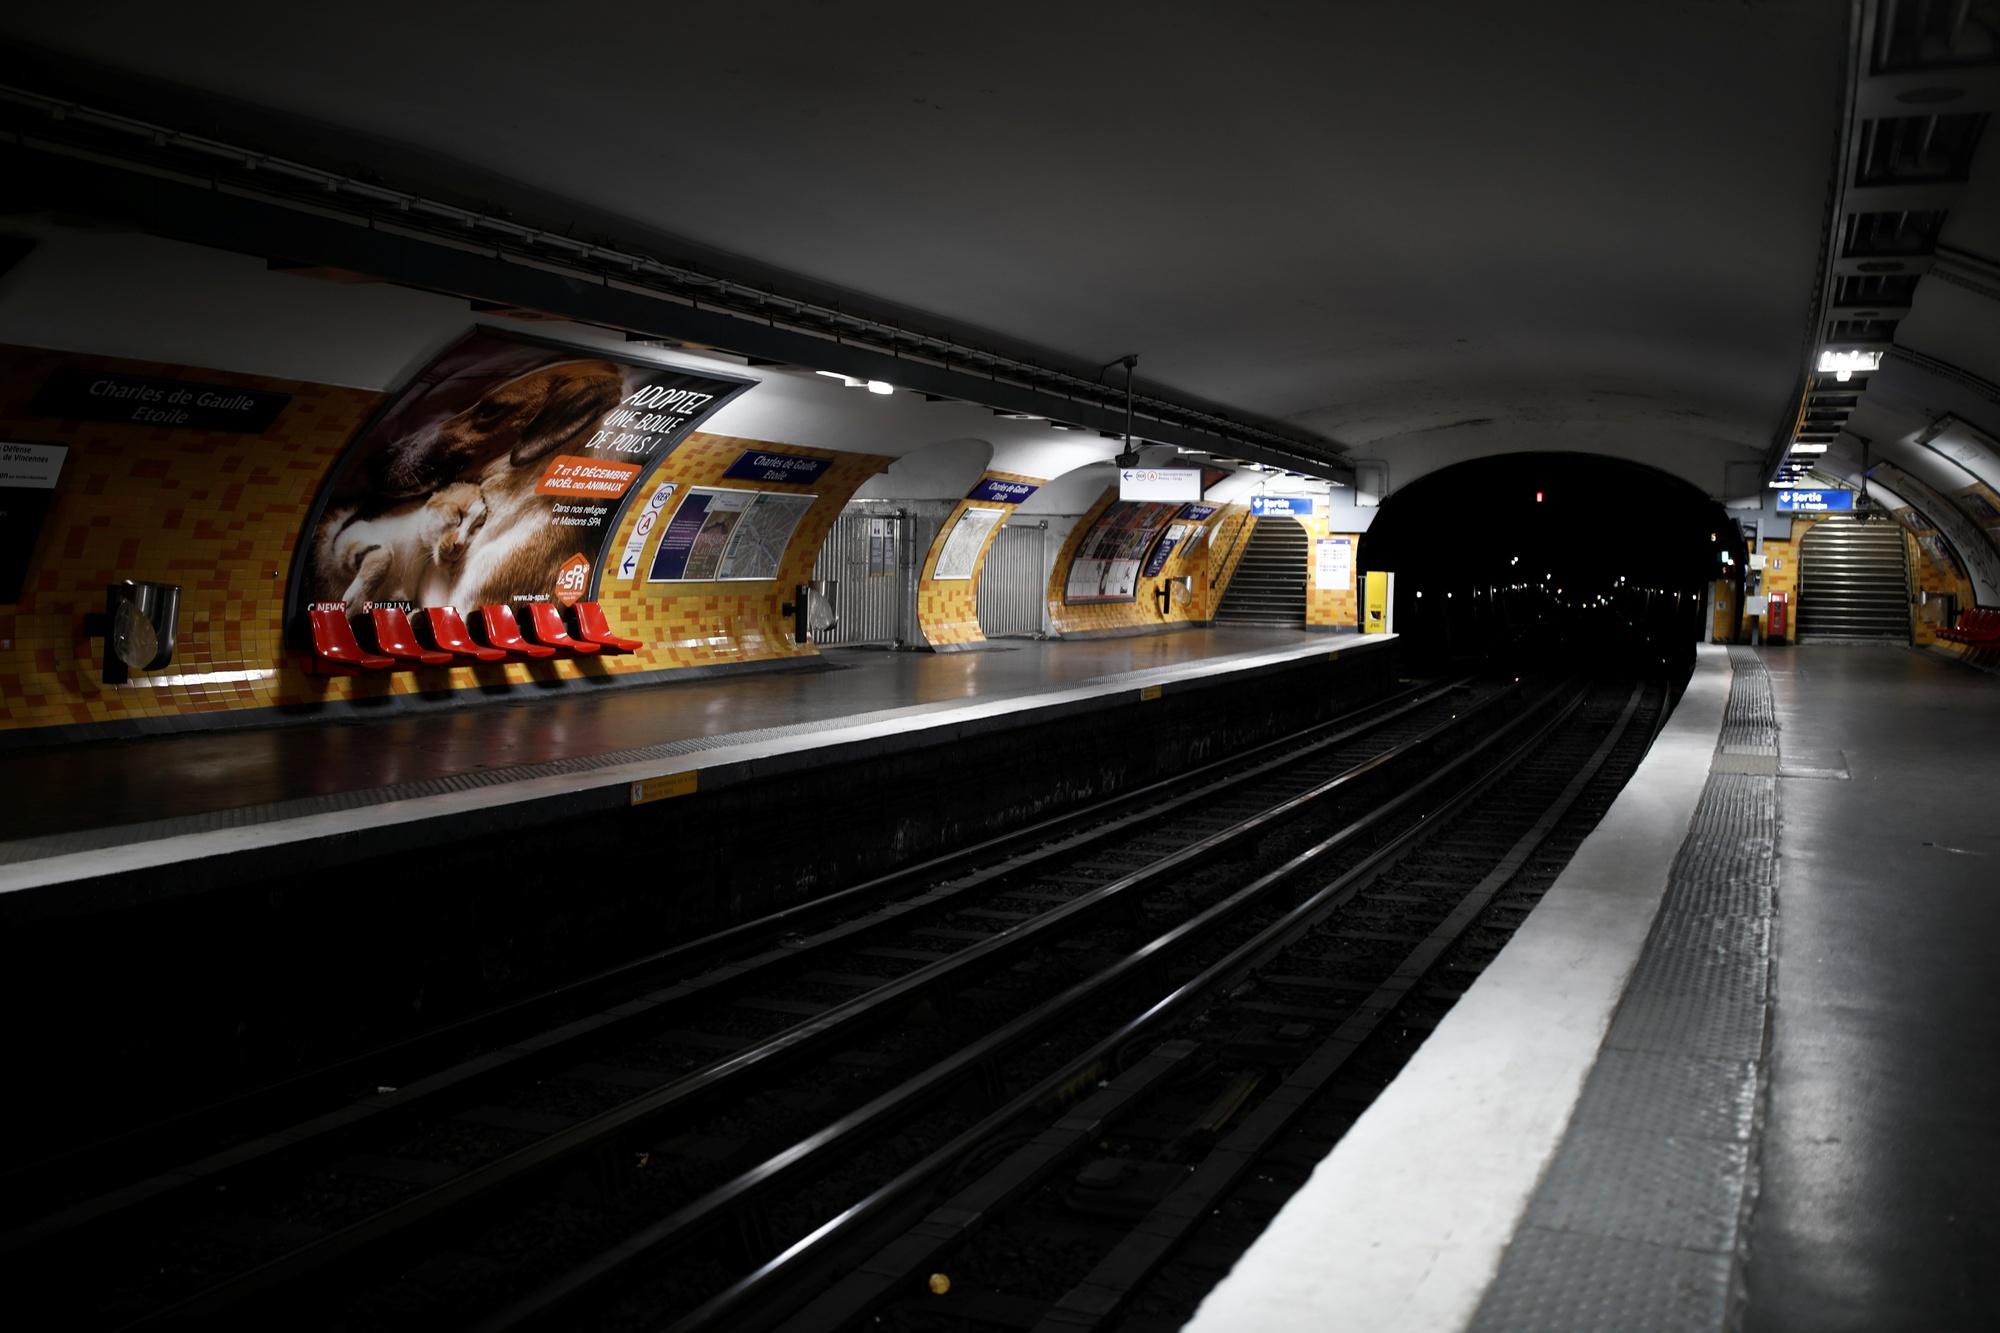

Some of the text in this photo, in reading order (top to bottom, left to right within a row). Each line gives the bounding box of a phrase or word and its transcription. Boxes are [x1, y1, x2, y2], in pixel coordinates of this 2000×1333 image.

[88, 379, 255, 412] Charles de Gaulle
[622, 384, 714, 415] ADOPTEZ
[130, 406, 189, 425] Etoile
[603, 409, 685, 435] UNE BOULE
[3, 444, 32, 454] Défense
[584, 430, 662, 455] DE POILS !
[14, 454, 49, 463] Vincennes
[753, 455, 819, 471] Charles de Gaulle
[553, 463, 633, 481] 7 ET 8 DÉCEMBRE
[544, 477, 573, 489] #NOËL
[584, 480, 625, 492] ANIMAUX
[656, 492, 671, 501] RER
[1792, 491, 1822, 502] Sortie
[552, 503, 571, 513] Dans
[570, 505, 584, 514] nos
[551, 516, 602, 527] et Maisons SPA
[642, 517, 652, 530] A
[563, 564, 585, 591] SPA
